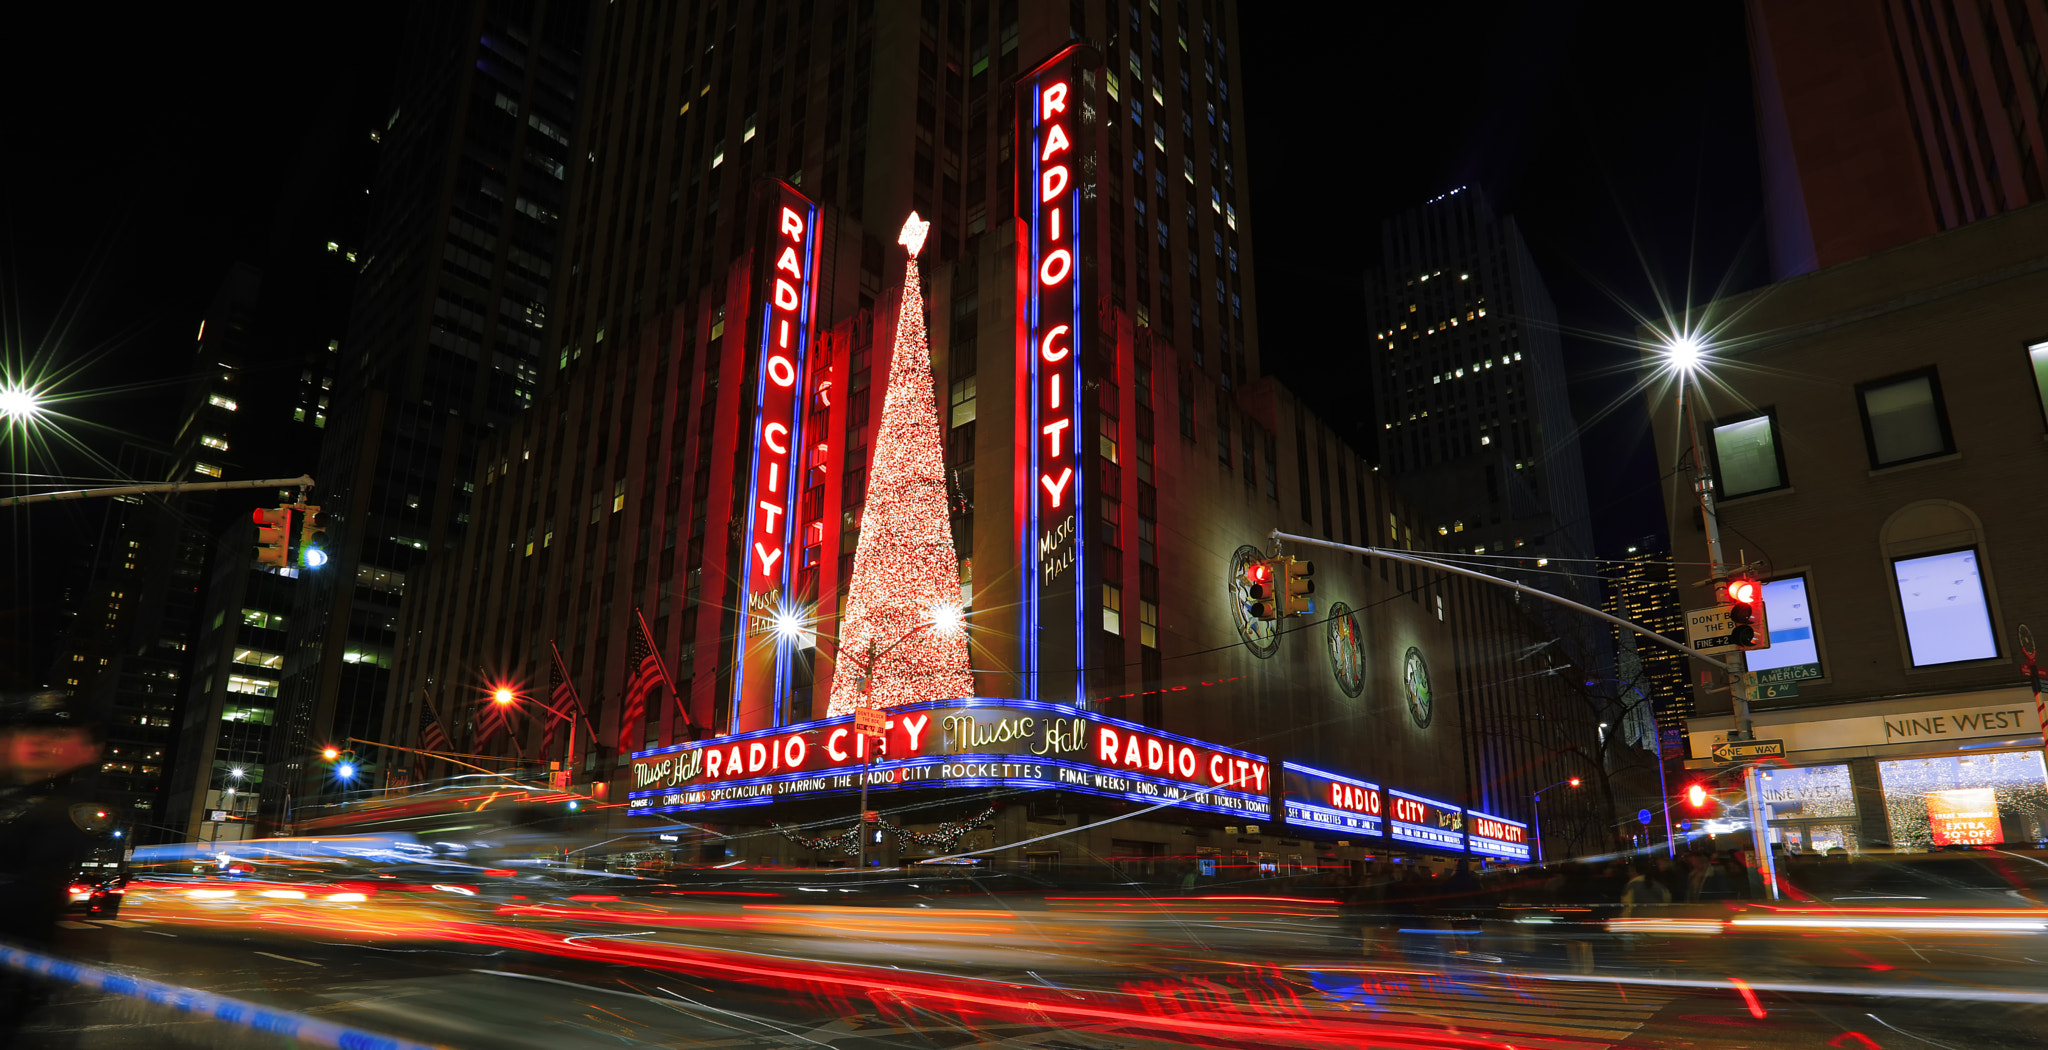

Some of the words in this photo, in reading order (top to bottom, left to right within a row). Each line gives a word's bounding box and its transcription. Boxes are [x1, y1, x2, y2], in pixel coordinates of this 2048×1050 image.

[1041, 82, 1071, 286] RADIO
[767, 206, 803, 387] RADIO
[1041, 325, 1072, 508] CITY
[755, 422, 788, 577] CITY
[1041, 515, 1075, 562] MUSIC
[1046, 546, 1075, 587] HALL
[748, 588, 779, 614] MUSIC
[1692, 611, 1720, 625] DON'T
[1705, 621, 1724, 633] THE
[1696, 637, 1713, 648] FINE
[1761, 667, 1818, 683] AMERICAS
[1767, 686, 1776, 697] 6
[1885, 716, 1947, 738] NINE
[1952, 709, 2025, 732] WEST
[634, 759, 671, 788] Music
[667, 747, 703, 787] Hall
[706, 735, 806, 778] RADIO
[942, 715, 1035, 752] Music
[1030, 718, 1089, 755] Hall
[1100, 727, 1196, 778] RADIO
[1210, 754, 1265, 791] CITY
[1719, 747, 1742, 757] ONE
[1754, 745, 1777, 754] WAY
[662, 790, 706, 806] CHRISTMAS
[710, 783, 773, 801] SPECTACULAR
[778, 777, 826, 794] STARRING
[833, 774, 852, 788] THE
[902, 765, 931, 781] CITY
[942, 763, 1042, 779] ROCKETTES
[1059, 768, 1089, 786] FINAL
[1095, 774, 1130, 792] WEEKS!
[1136, 782, 1159, 796] ENDS
[1163, 787, 1180, 800] JAN
[1182, 789, 1188, 801] 2
[1195, 792, 1210, 804] GET
[1214, 794, 1242, 810] TICKETS
[1245, 799, 1269, 813] TODAY!
[1798, 785, 1840, 797] WEST
[1288, 807, 1299, 818] SEE
[1332, 782, 1379, 814] RADIO
[1397, 798, 1424, 823] CITY
[1477, 817, 1503, 840] RADIO
[1505, 824, 1521, 843] CITY
[1946, 821, 1986, 831] EXTRA
[1968, 829, 1993, 838] OFF
